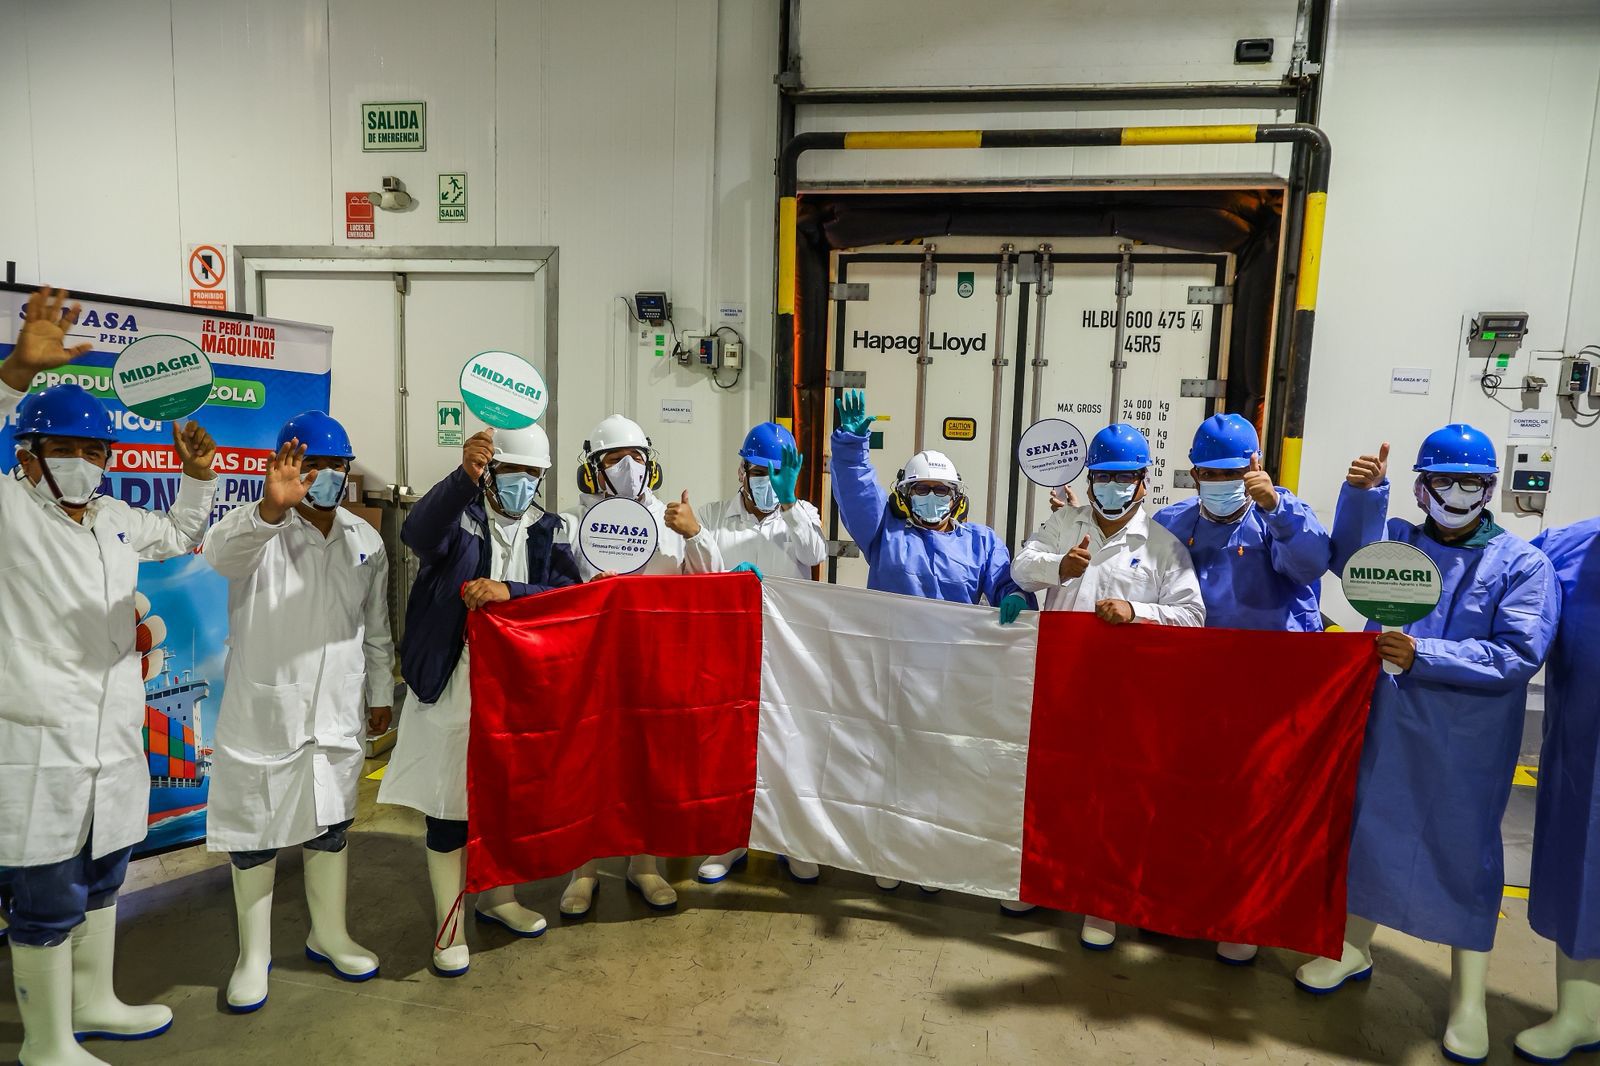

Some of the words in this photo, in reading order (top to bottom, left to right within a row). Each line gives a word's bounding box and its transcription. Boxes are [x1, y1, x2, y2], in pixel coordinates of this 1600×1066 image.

[367, 110, 419, 130] SALIDA
[368, 133, 376, 143] DE
[378, 132, 419, 143] EMERGENCIA
[441, 209, 464, 217] SALIDA
[19, 302, 138, 332] SASA
[1082, 310, 1119, 328] HLBU
[1125, 311, 1153, 329] 600
[1157, 311, 1186, 329] 475
[1191, 311, 1202, 330] 4
[203, 320, 216, 333] ¡EL
[219, 322, 242, 336] PERÚ
[245, 325, 251, 337] A
[253, 326, 275, 341] TODA
[201, 333, 275, 360] MÁQUINA!
[1124, 335, 1161, 353] 45R5
[119, 352, 200, 385] MIDAGRI
[32, 371, 113, 391] PRODU
[472, 363, 542, 401] MIDAGRI
[1057, 403, 1072, 413] MAX
[1077, 404, 1102, 413] GROSS
[1123, 400, 1133, 408] 34
[1136, 400, 1152, 409] 000
[1159, 400, 1170, 411] kg
[1122, 411, 1132, 420] 74
[1136, 412, 1151, 420] 960
[1158, 412, 1167, 421] lb
[1158, 428, 1168, 440] kg
[1026, 438, 1078, 457] SENASA
[1156, 439, 1165, 449] lb
[1060, 448, 1079, 457] PERU
[111, 449, 239, 471] TONELAS
[243, 457, 268, 472] DE
[1155, 456, 1166, 468] kg
[1154, 468, 1163, 477] lb
[225, 478, 265, 502] PAV
[1152, 496, 1169, 505] cuft
[590, 522, 649, 538] SENASA
[627, 537, 648, 545] PERU
[1350, 567, 1432, 582] MIDAGRI
